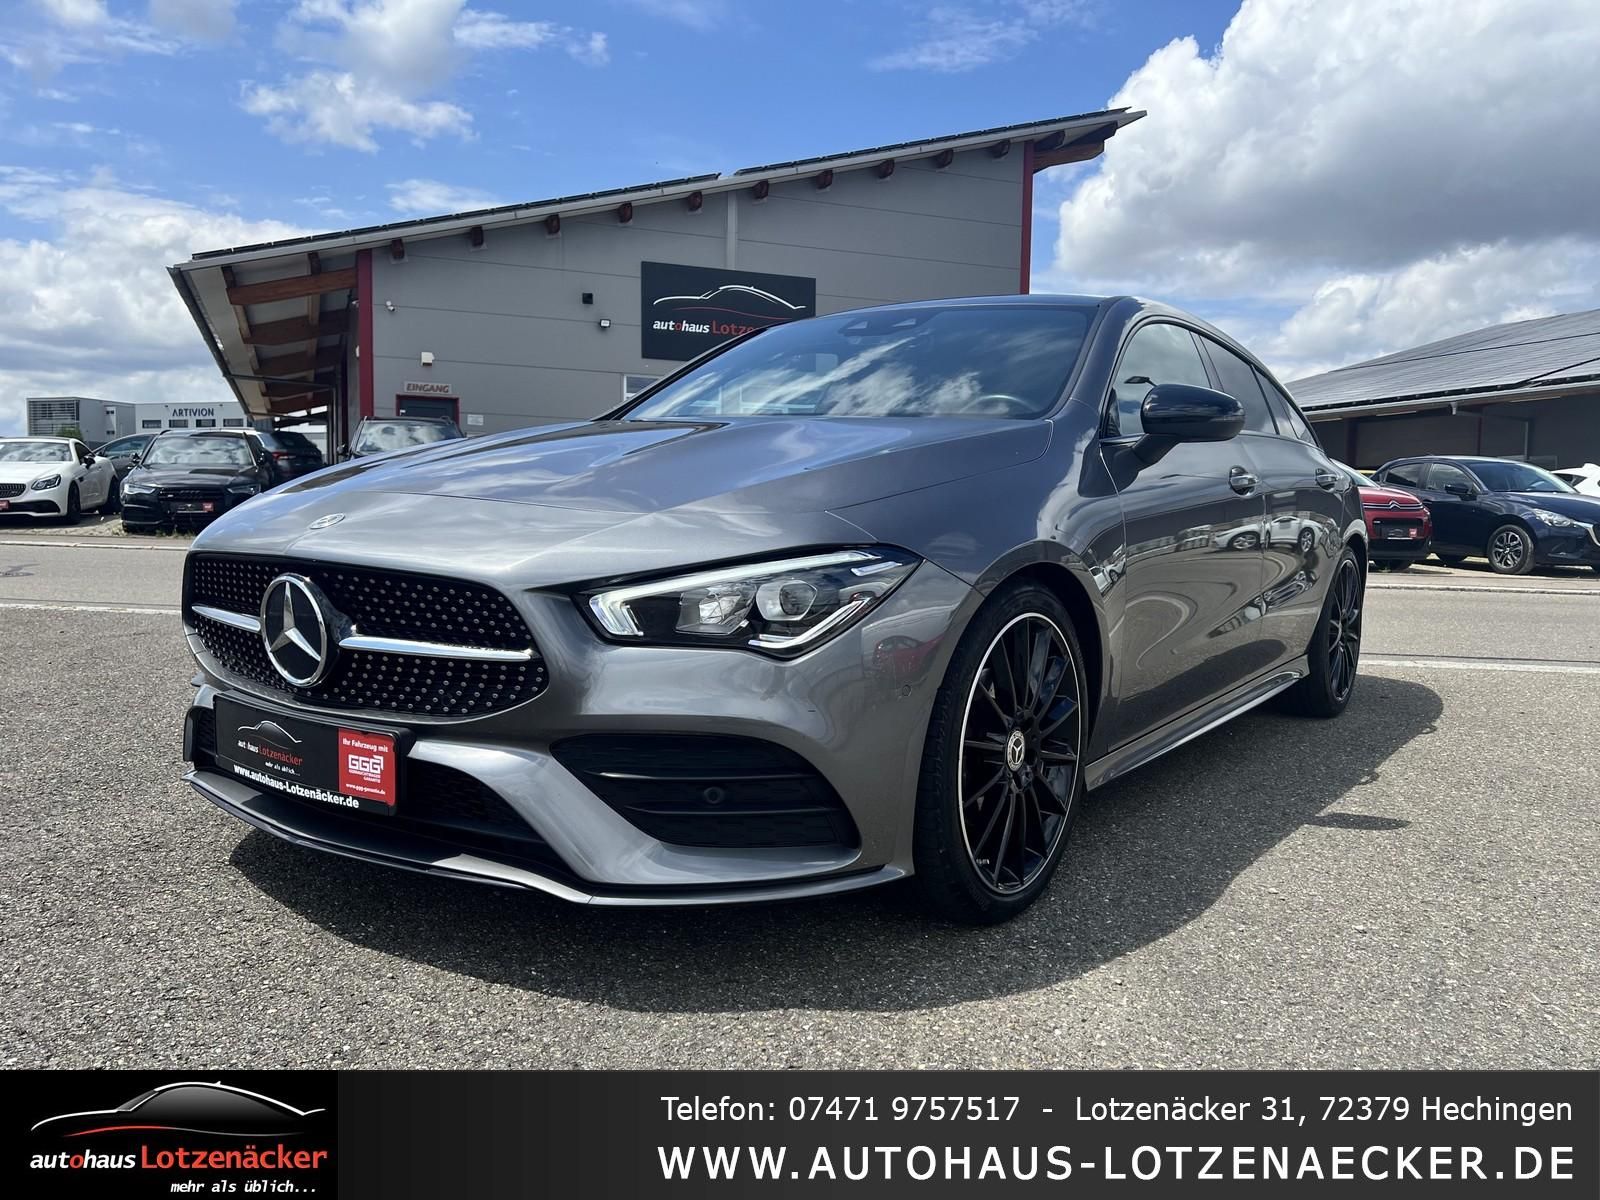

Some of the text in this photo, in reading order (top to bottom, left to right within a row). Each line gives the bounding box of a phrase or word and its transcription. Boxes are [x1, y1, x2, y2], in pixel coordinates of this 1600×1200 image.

[653, 320, 710, 334] autohaus
[406, 383, 449, 393] EINGANG
[172, 407, 214, 417] ARTIVION
[237, 740, 259, 753] authaus
[342, 737, 389, 753] Ihr Fahrzeug mit
[348, 754, 381, 774] GGG
[233, 764, 360, 809] www.autohaus-Lotzenäcker.de
